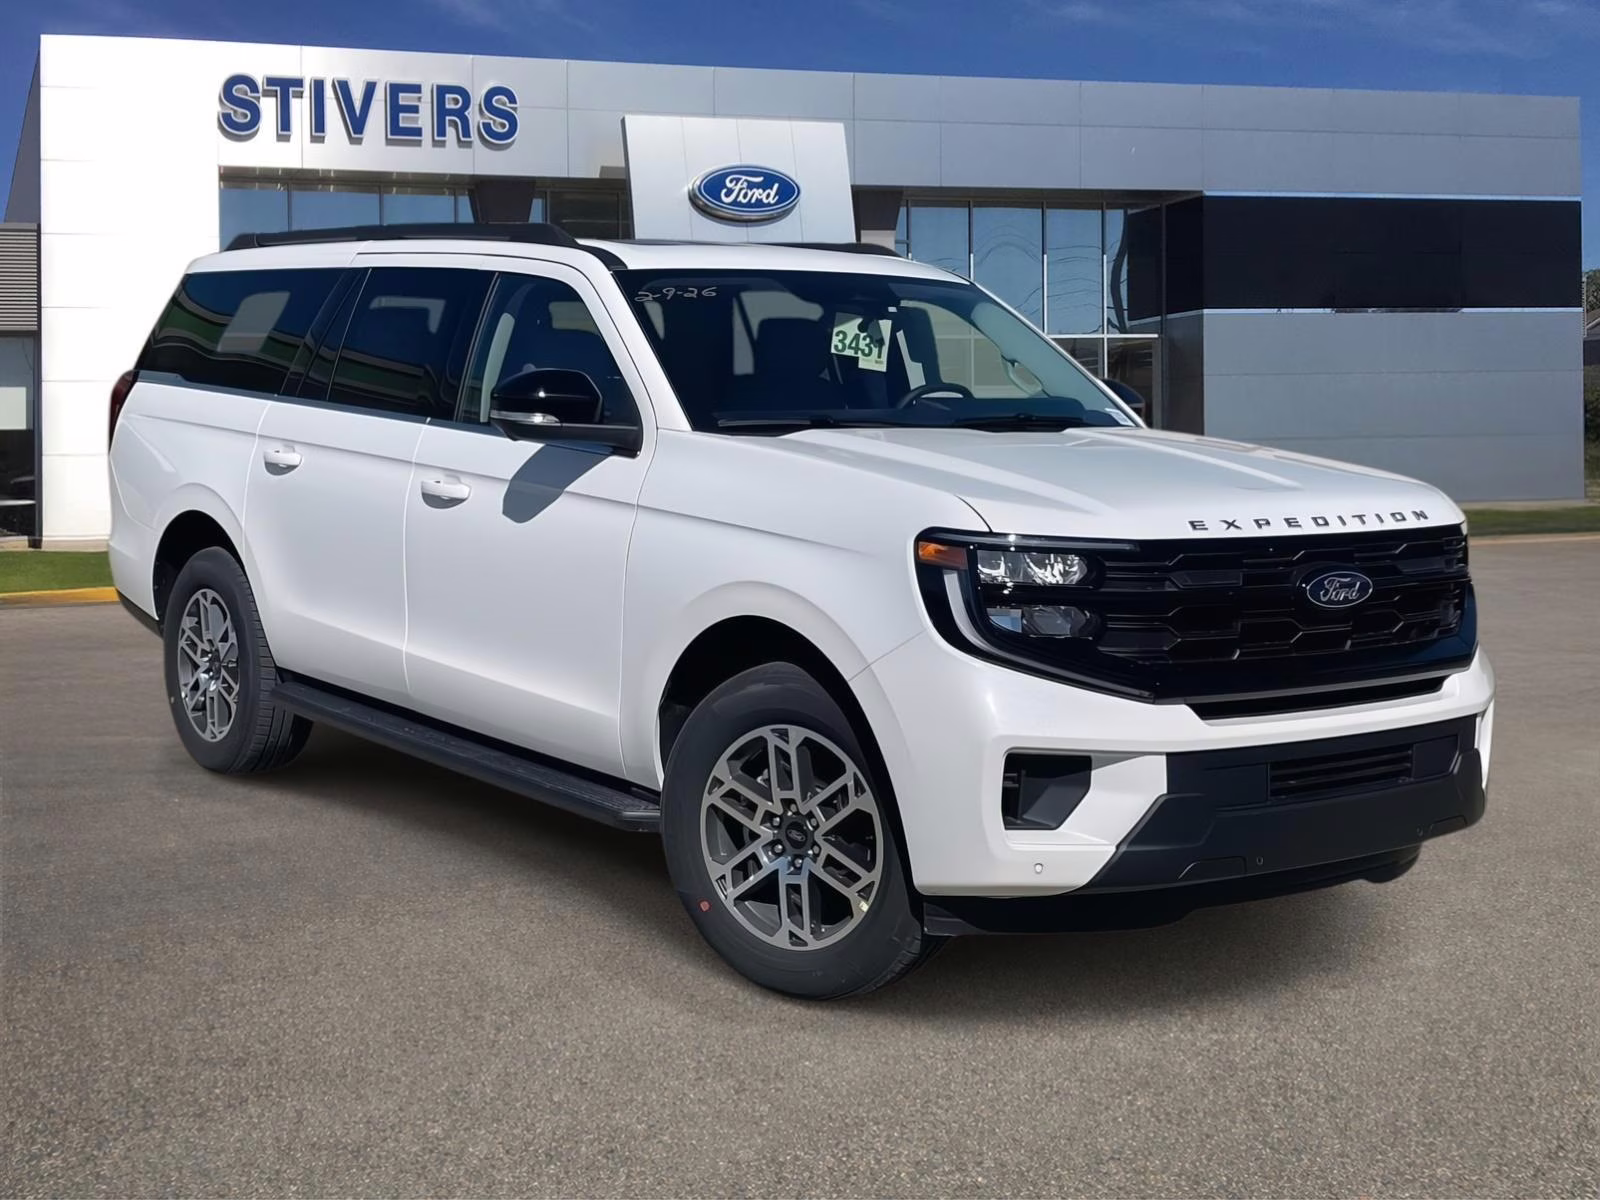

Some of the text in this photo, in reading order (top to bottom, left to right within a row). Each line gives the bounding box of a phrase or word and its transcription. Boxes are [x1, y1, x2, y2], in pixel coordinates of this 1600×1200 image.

[219, 73, 519, 145] STIVERS
[721, 174, 779, 204] Ford
[634, 286, 717, 301] 2-9-26
[833, 330, 886, 359] 3431
[1188, 510, 1429, 531] EXPEDITION
[1320, 576, 1360, 601] Ford
